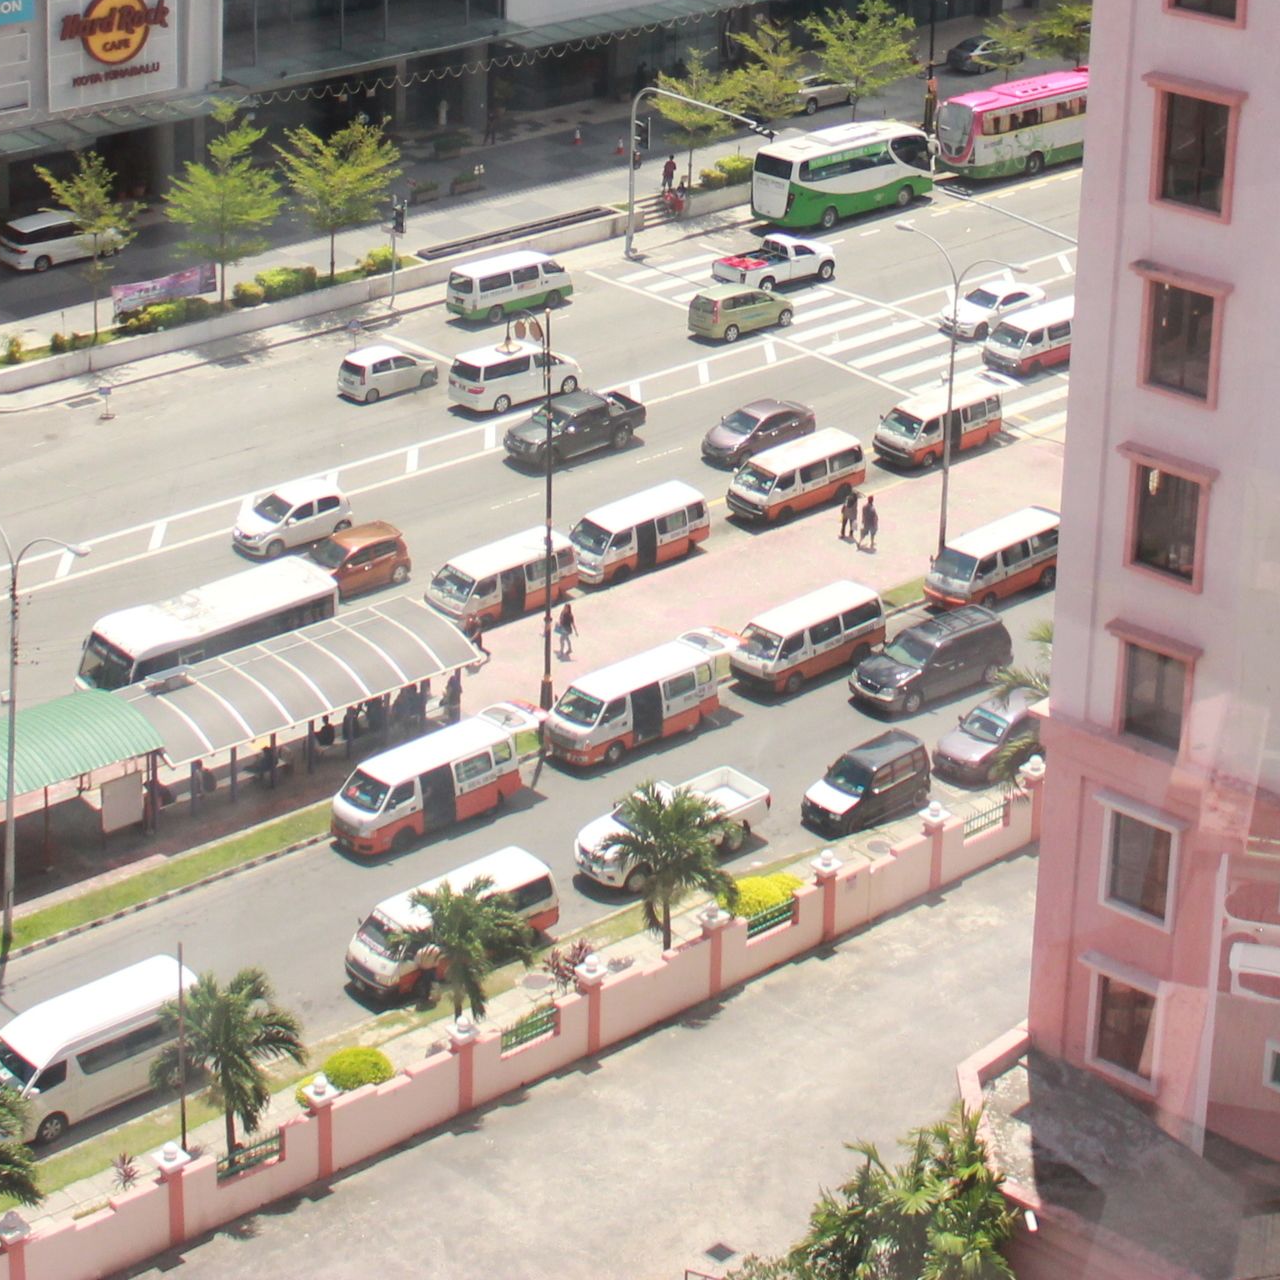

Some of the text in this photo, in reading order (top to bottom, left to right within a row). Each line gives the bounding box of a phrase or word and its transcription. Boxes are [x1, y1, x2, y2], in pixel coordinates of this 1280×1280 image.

[60, 0, 169, 41] Hard Rock
[102, 38, 131, 52] CAFE
[72, 62, 160, 88] KOTA KINABALU
